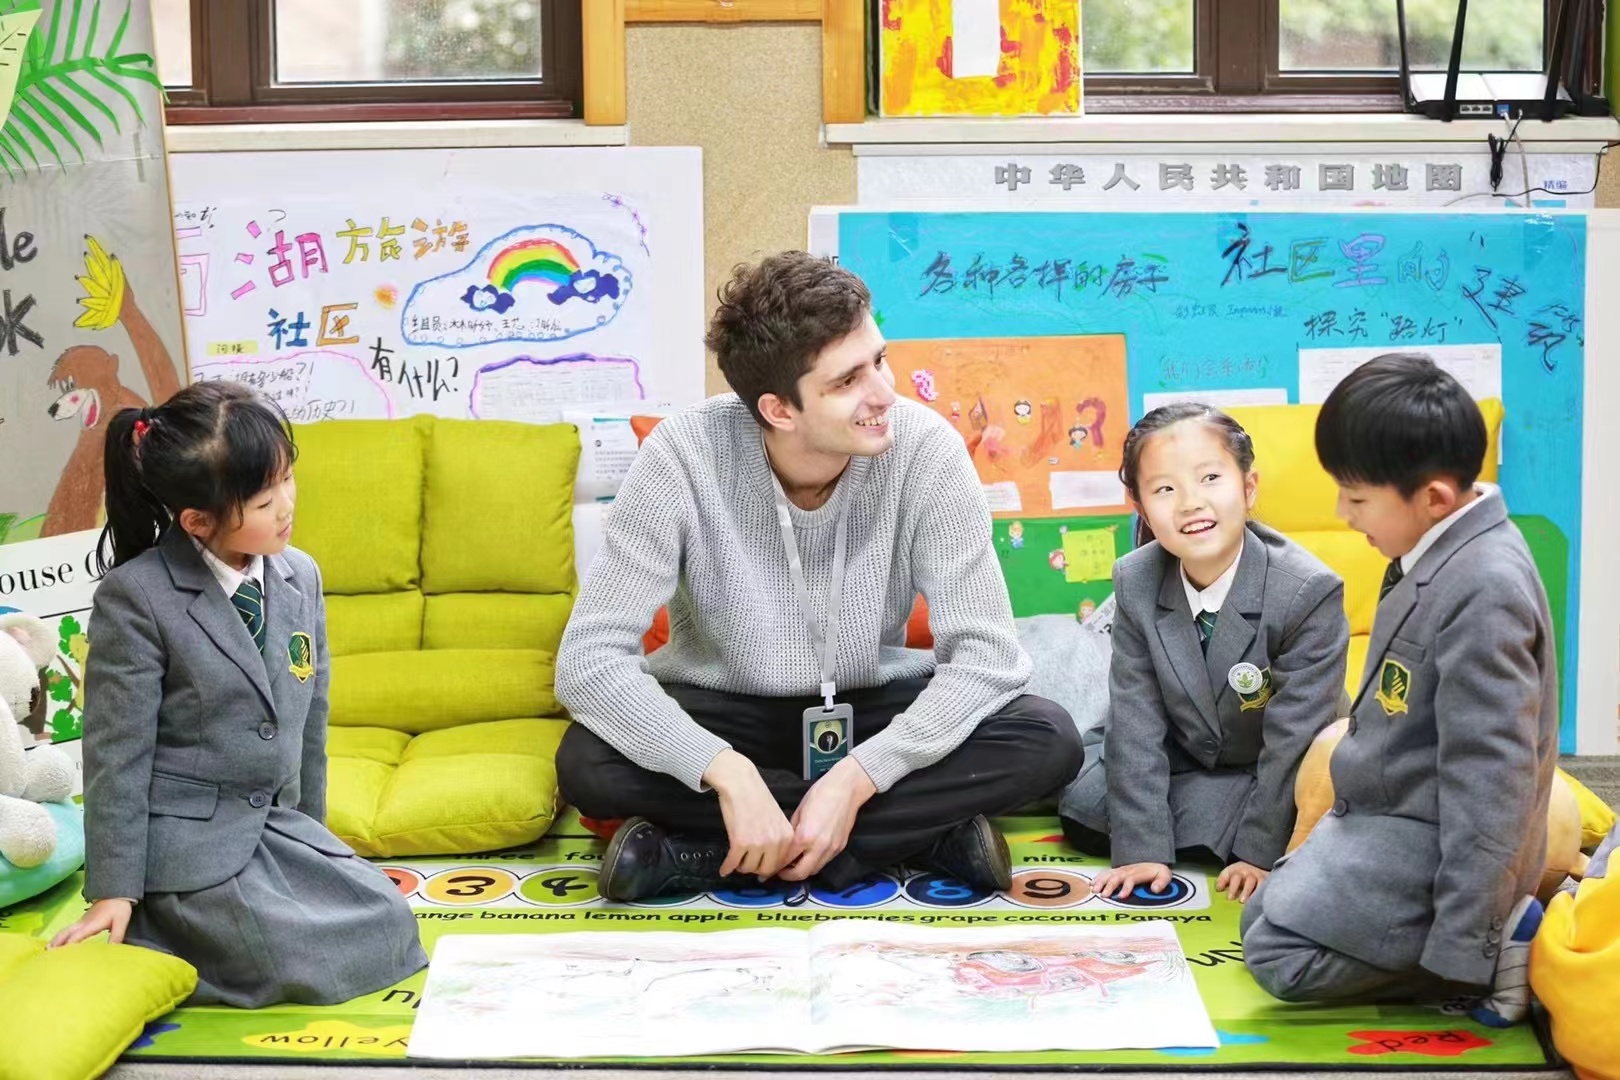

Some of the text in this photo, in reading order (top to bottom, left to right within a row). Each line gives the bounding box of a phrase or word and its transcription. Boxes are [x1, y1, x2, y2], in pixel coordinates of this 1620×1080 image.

[994, 162, 1463, 193] 中华人民共和国地图
[1219, 222, 1450, 292] 社区里的
[267, 302, 360, 351] 社区
[1303, 307, 1464, 343] 探究“路灯”
[368, 336, 459, 401] 有什么?
[1023, 853, 1083, 863] nine
[446, 876, 496, 896] 3
[541, 876, 589, 897] 4
[926, 880, 974, 900] 8
[1022, 878, 1071, 899] 9
[414, 911, 1212, 924] ange banana lemon apple blueberries grape coconut Papaya
[260, 1033, 410, 1049] Yellow
[1376, 1032, 1468, 1052] Red
